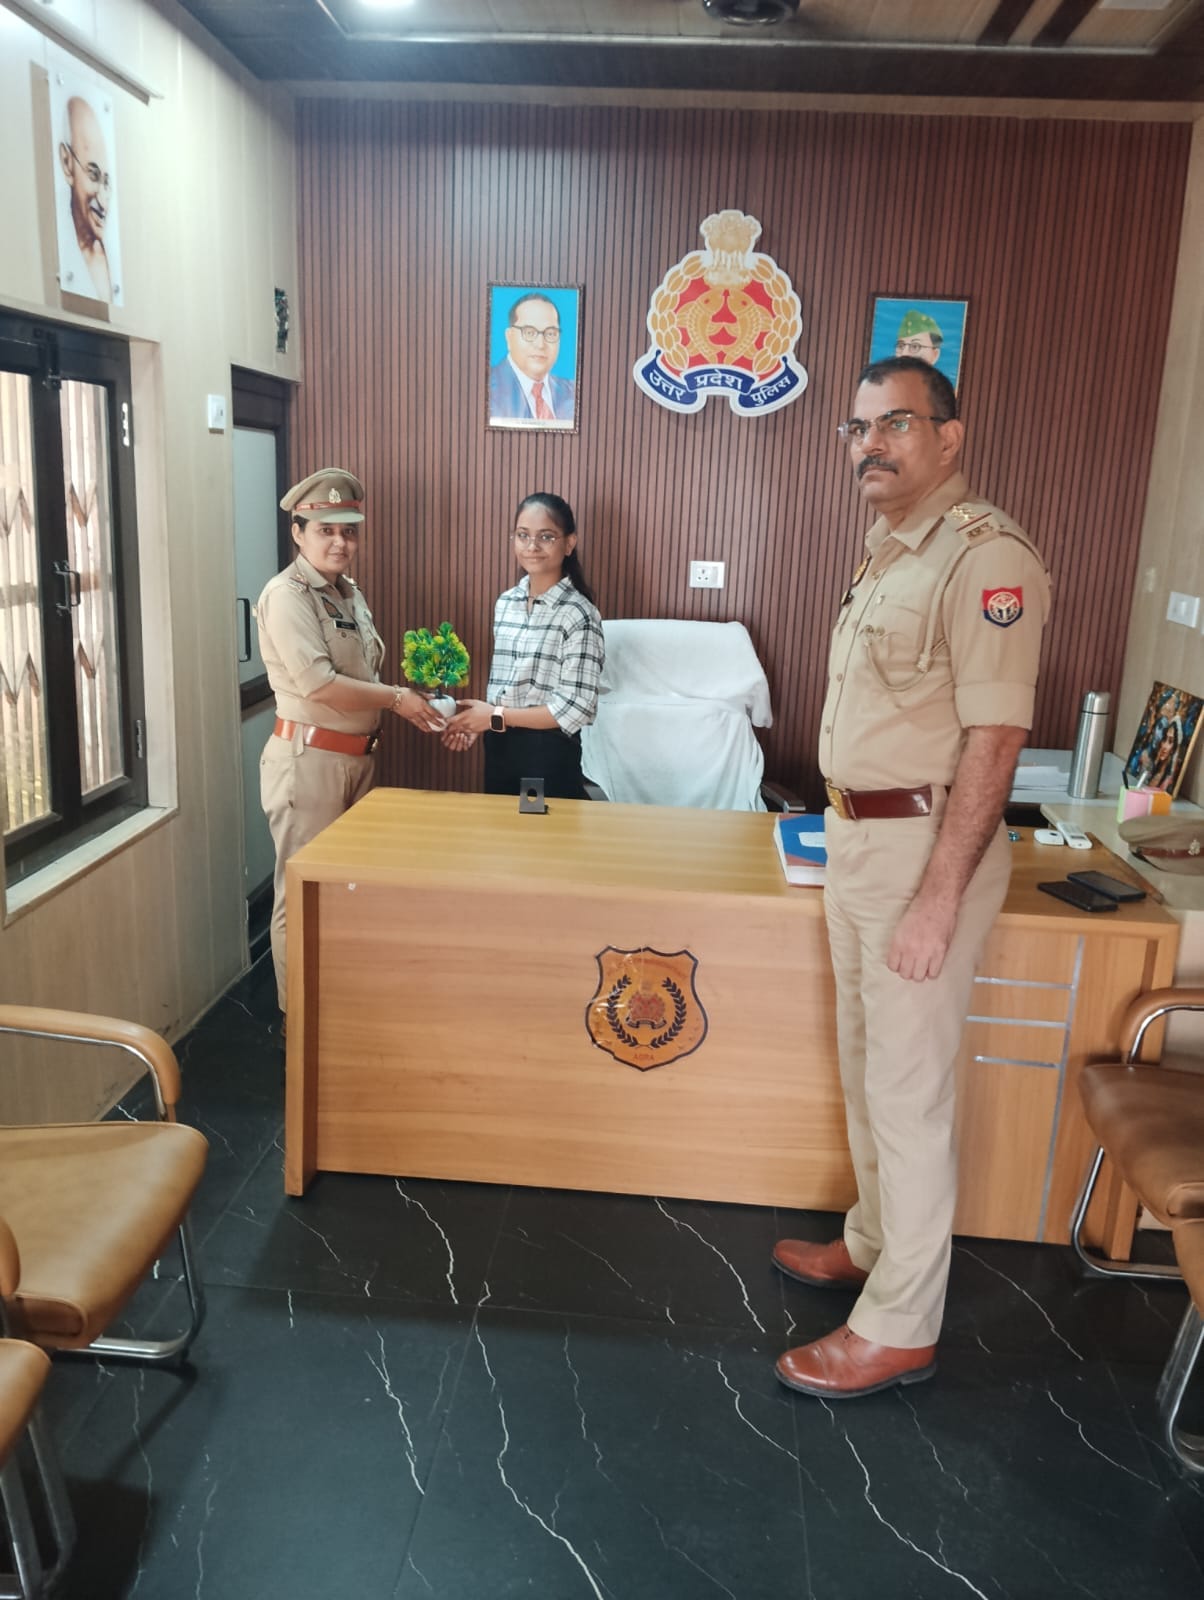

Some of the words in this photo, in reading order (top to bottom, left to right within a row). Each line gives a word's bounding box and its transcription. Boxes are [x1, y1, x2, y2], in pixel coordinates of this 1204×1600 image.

[649, 369, 685, 401] उत्तर
[694, 368, 743, 390] प्रदेश
[750, 375, 791, 406] पुलिस
